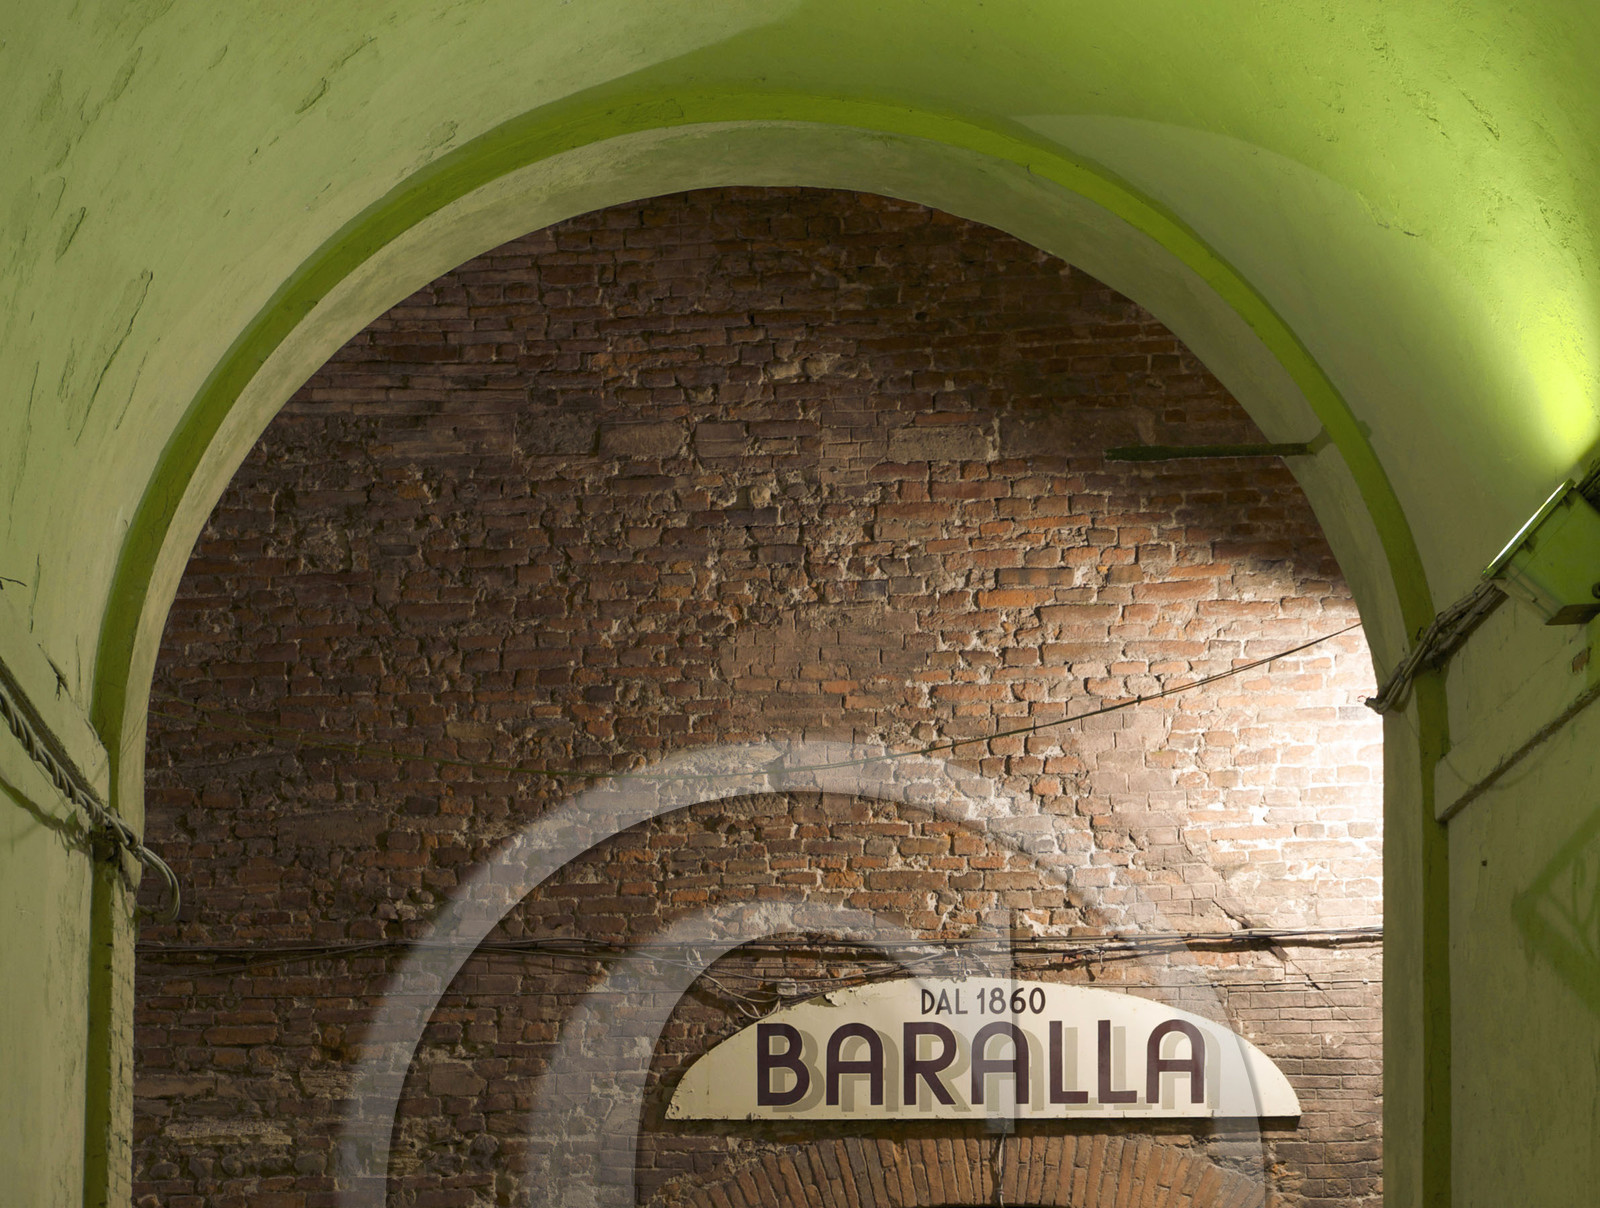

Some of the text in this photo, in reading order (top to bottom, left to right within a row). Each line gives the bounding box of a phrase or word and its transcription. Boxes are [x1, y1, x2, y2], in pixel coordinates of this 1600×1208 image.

[920, 986, 1047, 1015] DAL 1860
[756, 1018, 1206, 1108] BARALLA
